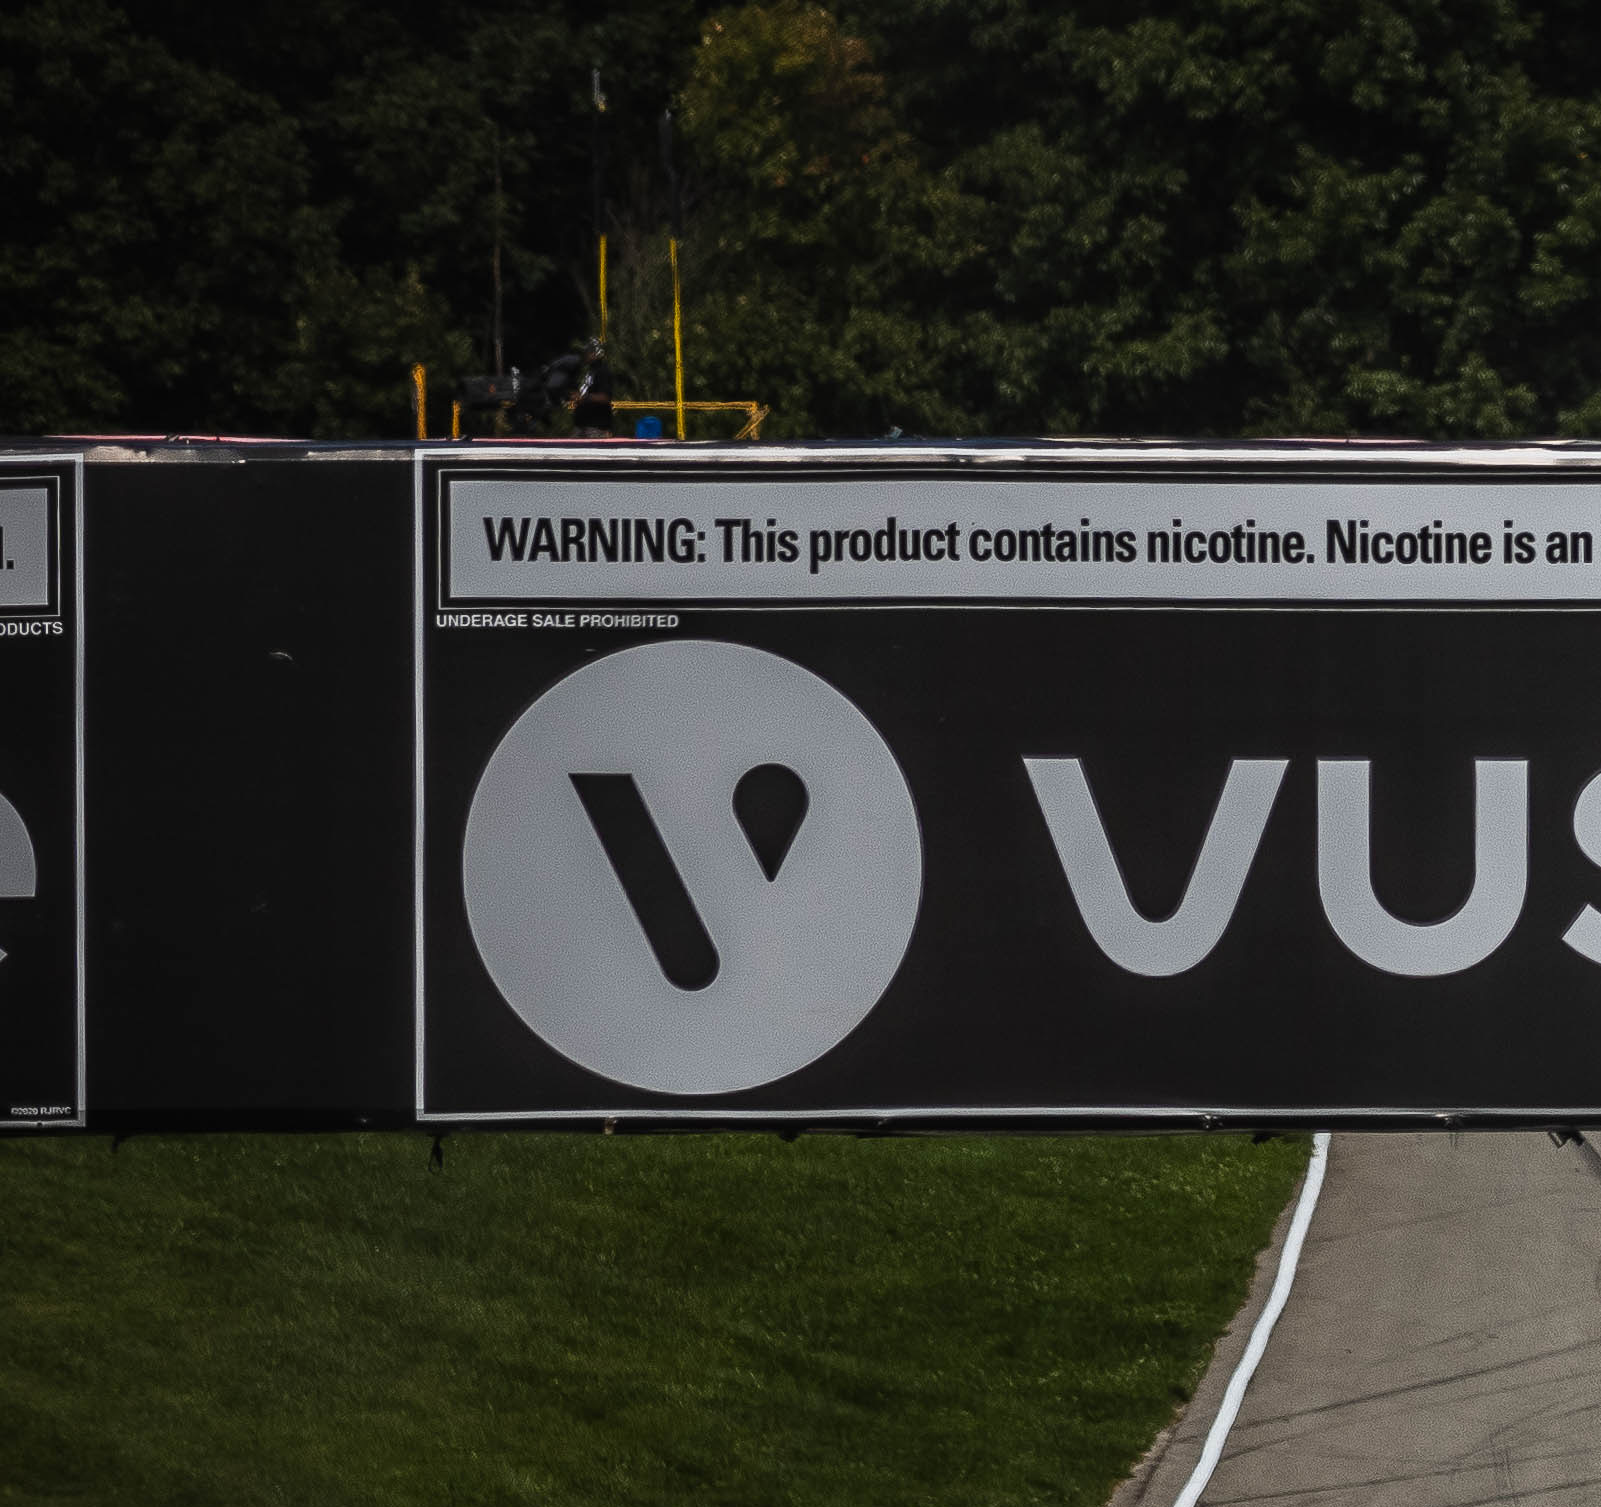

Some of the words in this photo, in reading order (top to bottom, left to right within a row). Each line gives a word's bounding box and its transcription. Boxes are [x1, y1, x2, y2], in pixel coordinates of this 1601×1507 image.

[483, 517, 705, 563] WARNING:
[715, 519, 799, 562] This
[810, 517, 960, 574] product
[969, 518, 1136, 562] contains
[1148, 519, 1314, 563] nicotine.
[1327, 520, 1491, 564] Nicotine
[1504, 520, 1535, 563] is
[1546, 532, 1592, 564] an
[437, 614, 528, 628] UNDERAGE
[532, 614, 575, 628] SALE
[580, 614, 679, 628] PROHIBITED
